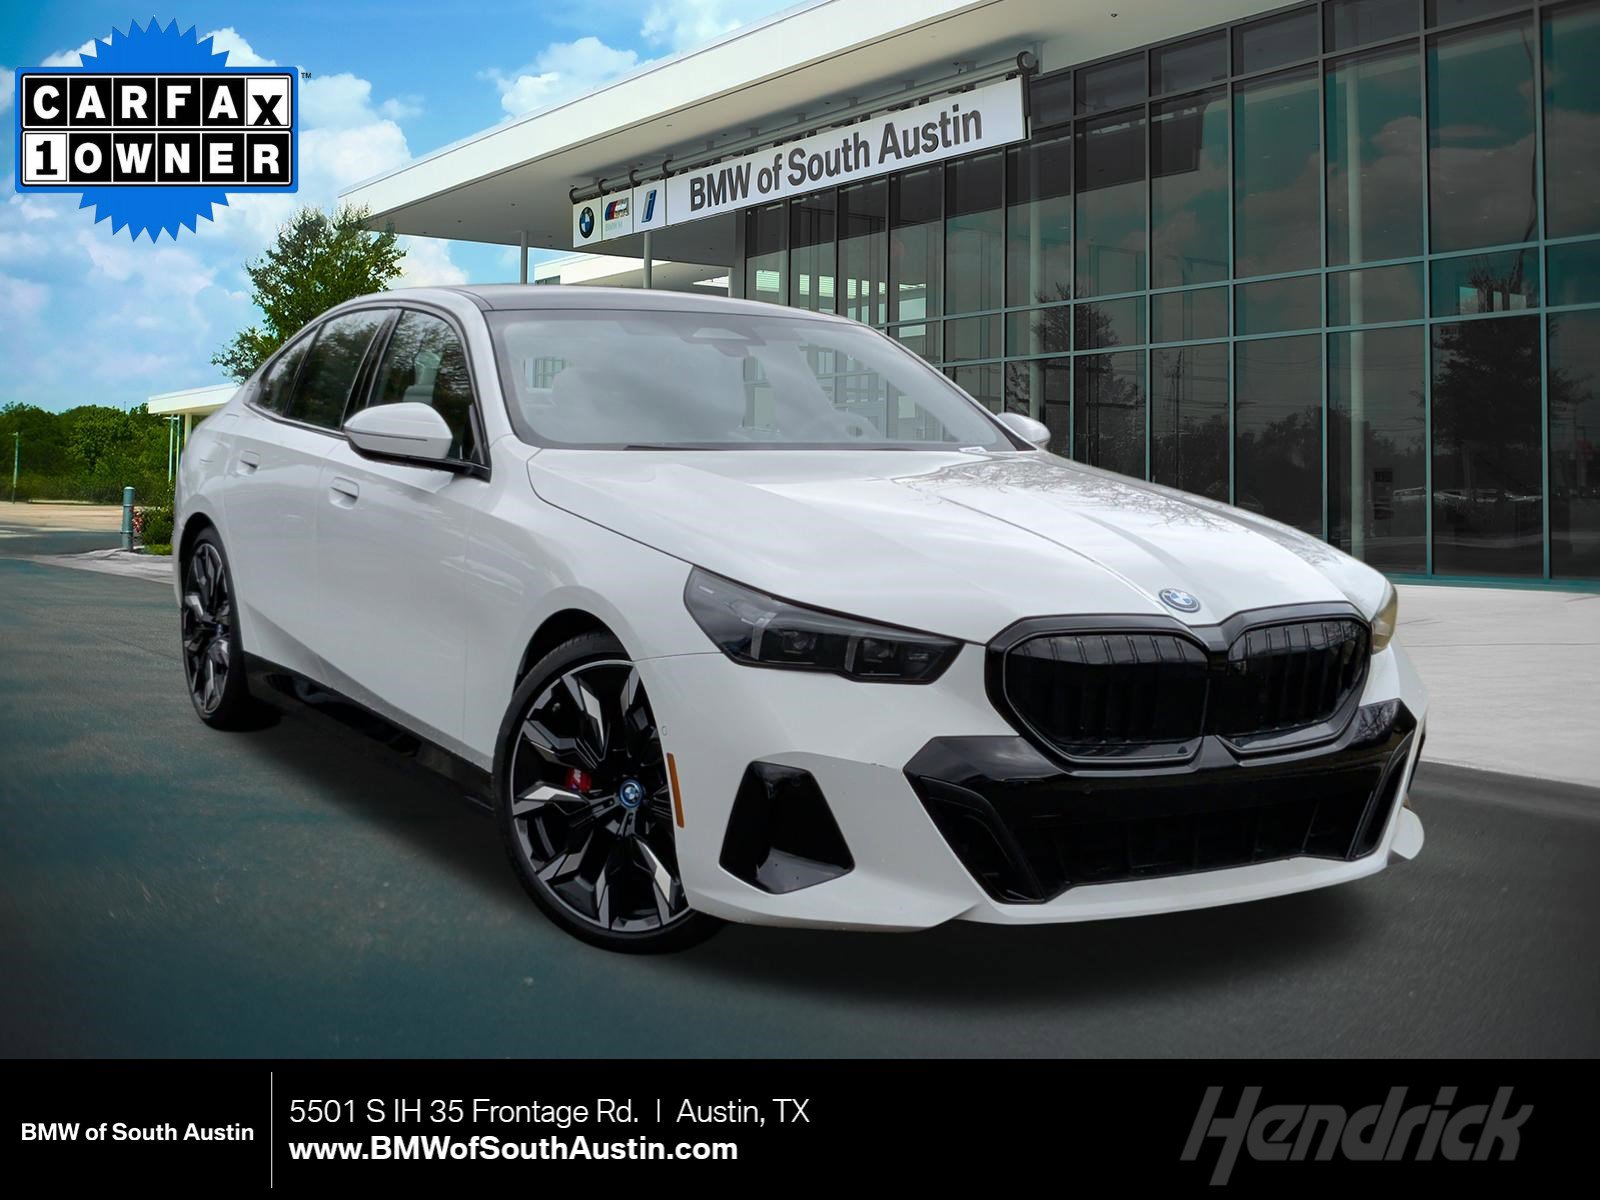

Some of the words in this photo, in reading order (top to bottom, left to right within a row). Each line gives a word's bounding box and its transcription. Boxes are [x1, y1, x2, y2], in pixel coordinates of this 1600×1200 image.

[690, 162, 751, 211] BMW
[757, 153, 783, 194] of
[788, 132, 870, 186] South
[878, 104, 983, 163] Austin
